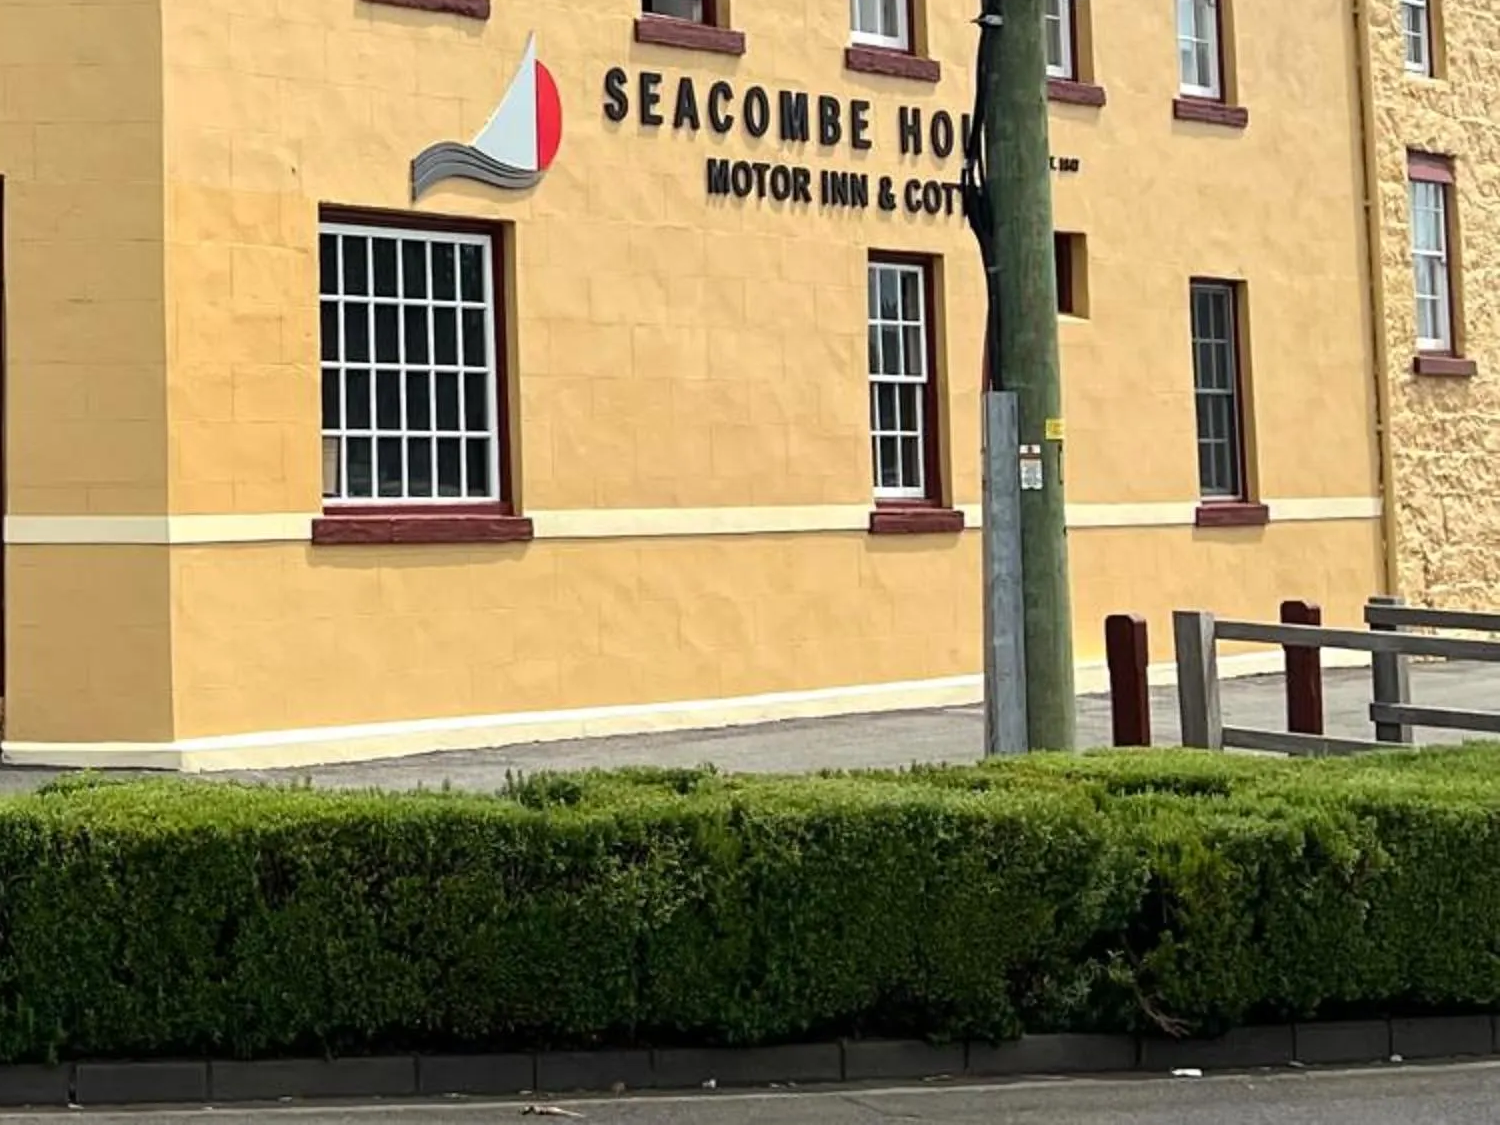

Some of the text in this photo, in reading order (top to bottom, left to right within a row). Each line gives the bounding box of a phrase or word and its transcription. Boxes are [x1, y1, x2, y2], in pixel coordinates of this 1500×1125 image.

[603, 67, 872, 150] SEACOMBE
[706, 157, 811, 203] MOTOR
[821, 169, 868, 208] INN
[877, 175, 897, 211] &
